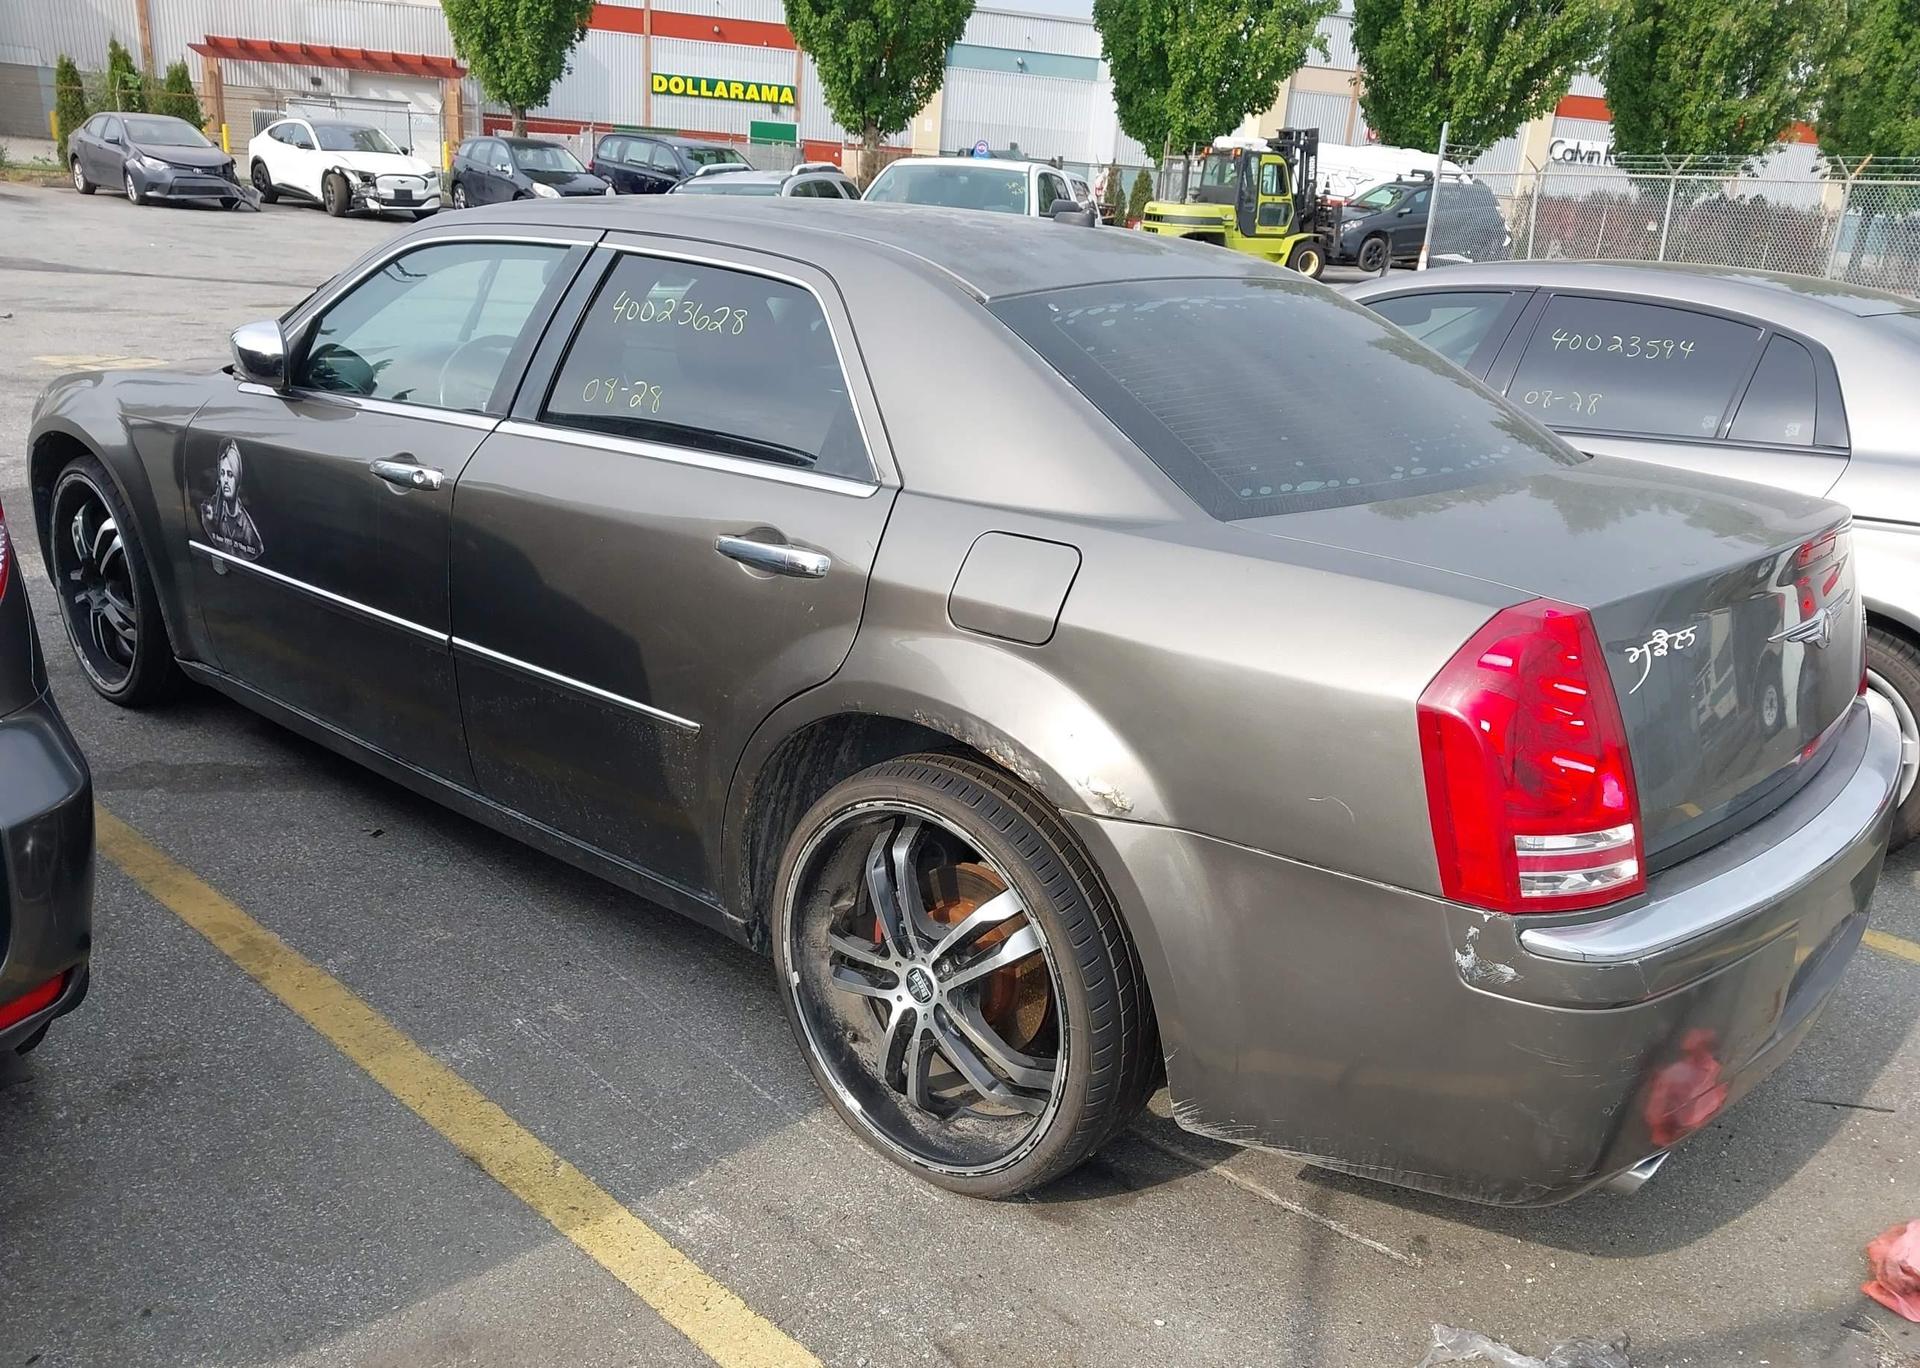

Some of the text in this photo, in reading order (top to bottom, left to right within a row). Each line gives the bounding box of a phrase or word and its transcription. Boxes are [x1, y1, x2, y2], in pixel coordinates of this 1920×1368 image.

[653, 75, 794, 104] DOLLARAMA
[1550, 140, 1601, 165] Calvin
[613, 291, 748, 334] 40023628
[1552, 328, 1696, 359] 40023594
[583, 378, 663, 414] 08-28
[1524, 390, 1603, 416] 08-28
